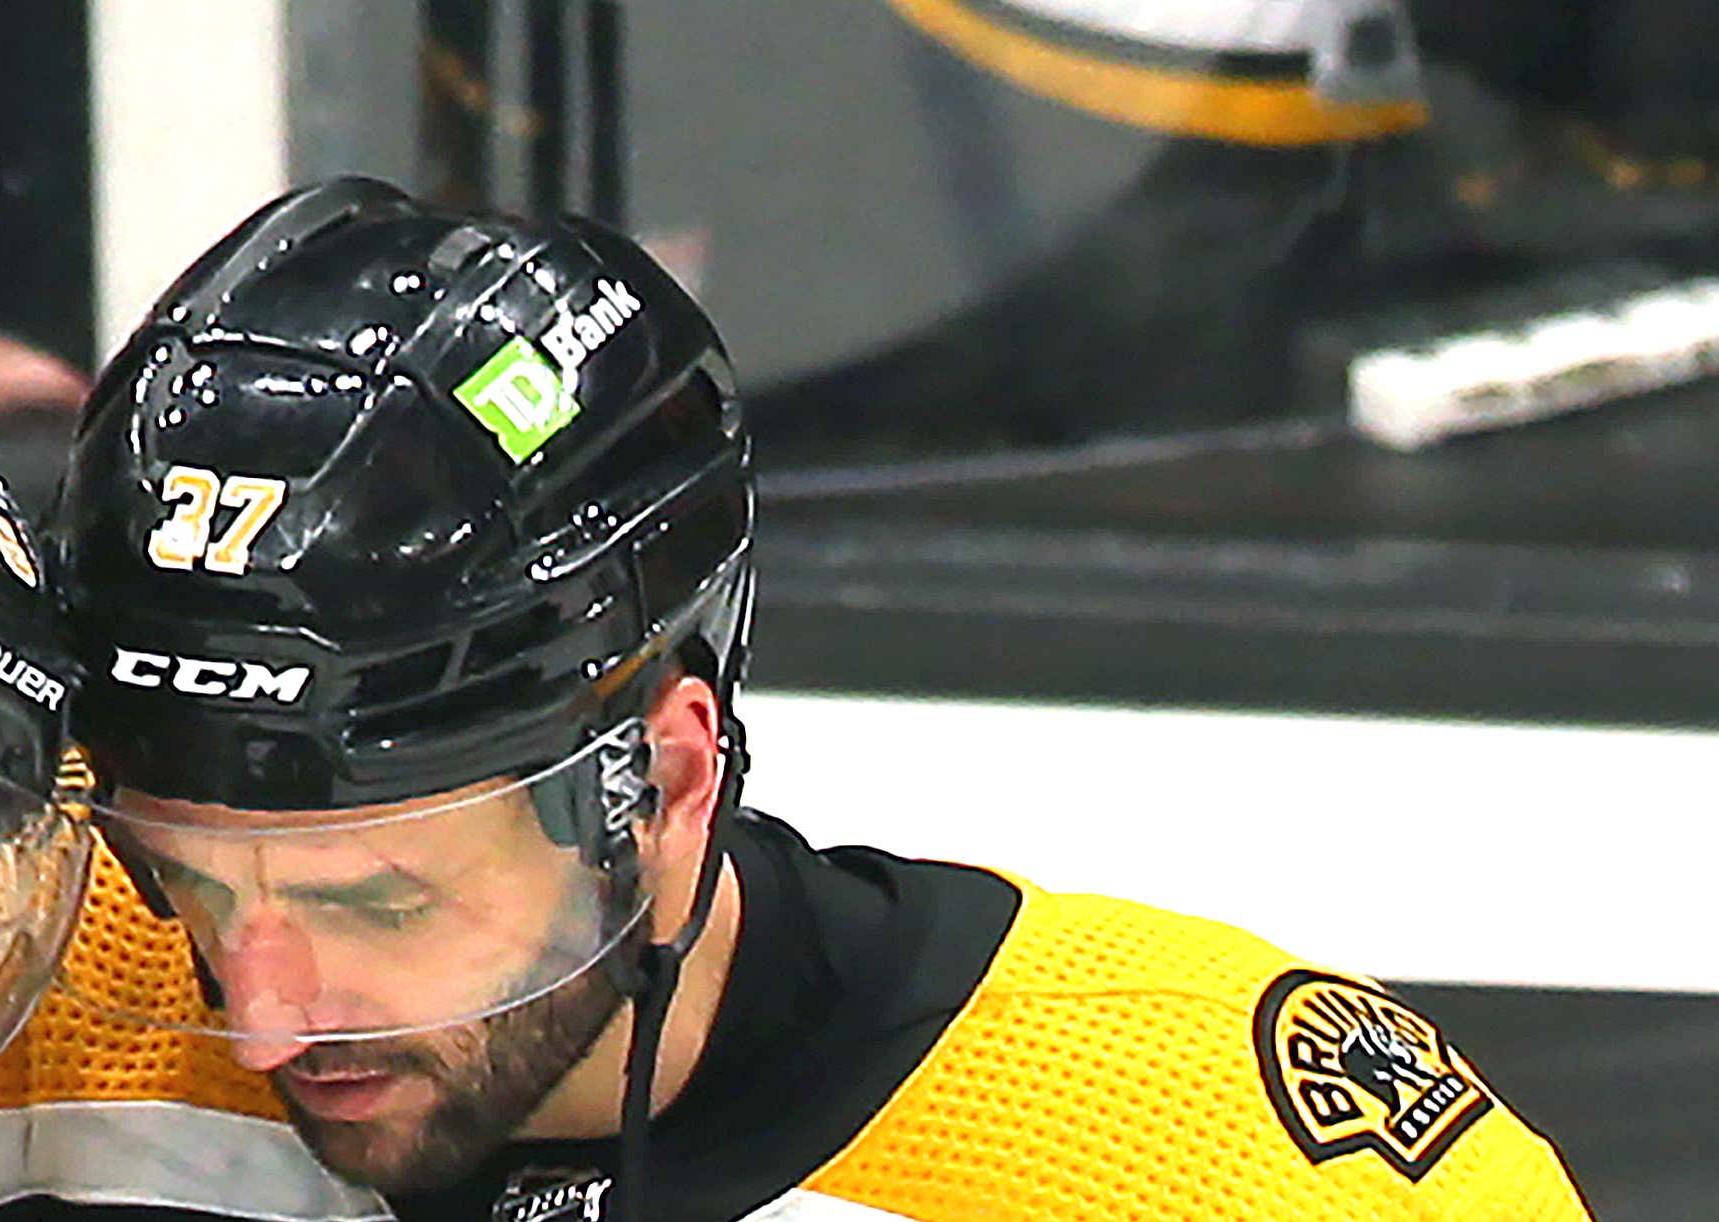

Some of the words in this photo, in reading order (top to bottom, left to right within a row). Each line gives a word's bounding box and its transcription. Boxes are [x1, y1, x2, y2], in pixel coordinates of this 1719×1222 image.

[472, 360, 557, 433] TD
[539, 279, 641, 370] Bank
[148, 466, 286, 574] 37
[111, 646, 310, 702] CCM
